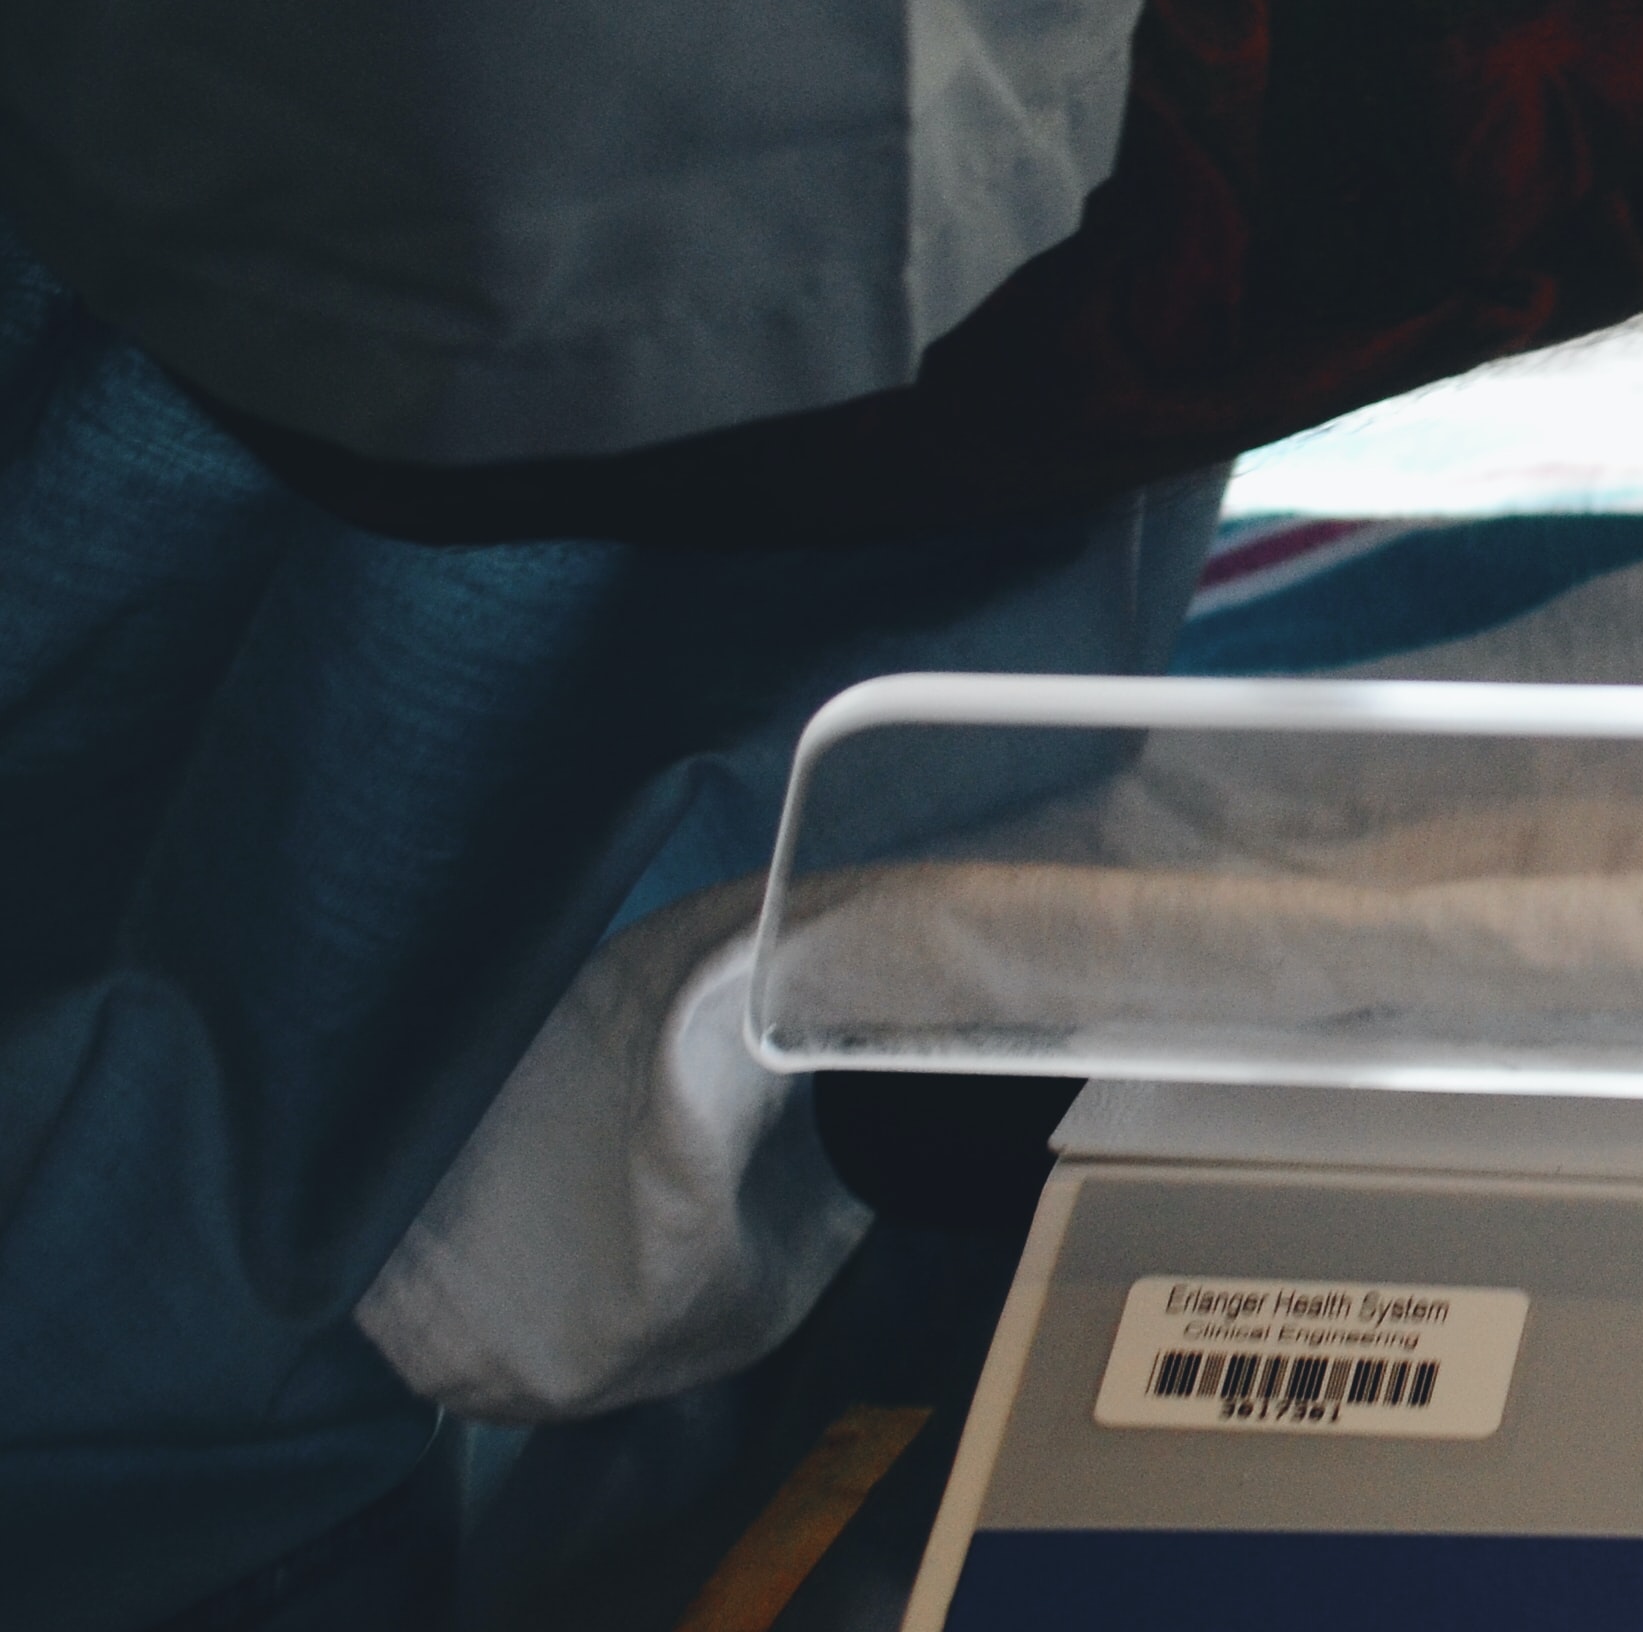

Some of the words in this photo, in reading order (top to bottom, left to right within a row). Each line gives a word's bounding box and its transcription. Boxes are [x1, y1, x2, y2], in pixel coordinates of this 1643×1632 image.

[1165, 1283, 1269, 1321] Erlanger
[1273, 1288, 1351, 1320] Health
[1357, 1290, 1449, 1328] System
[1183, 1320, 1270, 1342] Clinical
[1277, 1325, 1420, 1351] Engineering
[1220, 1398, 1340, 1422] 3017301
